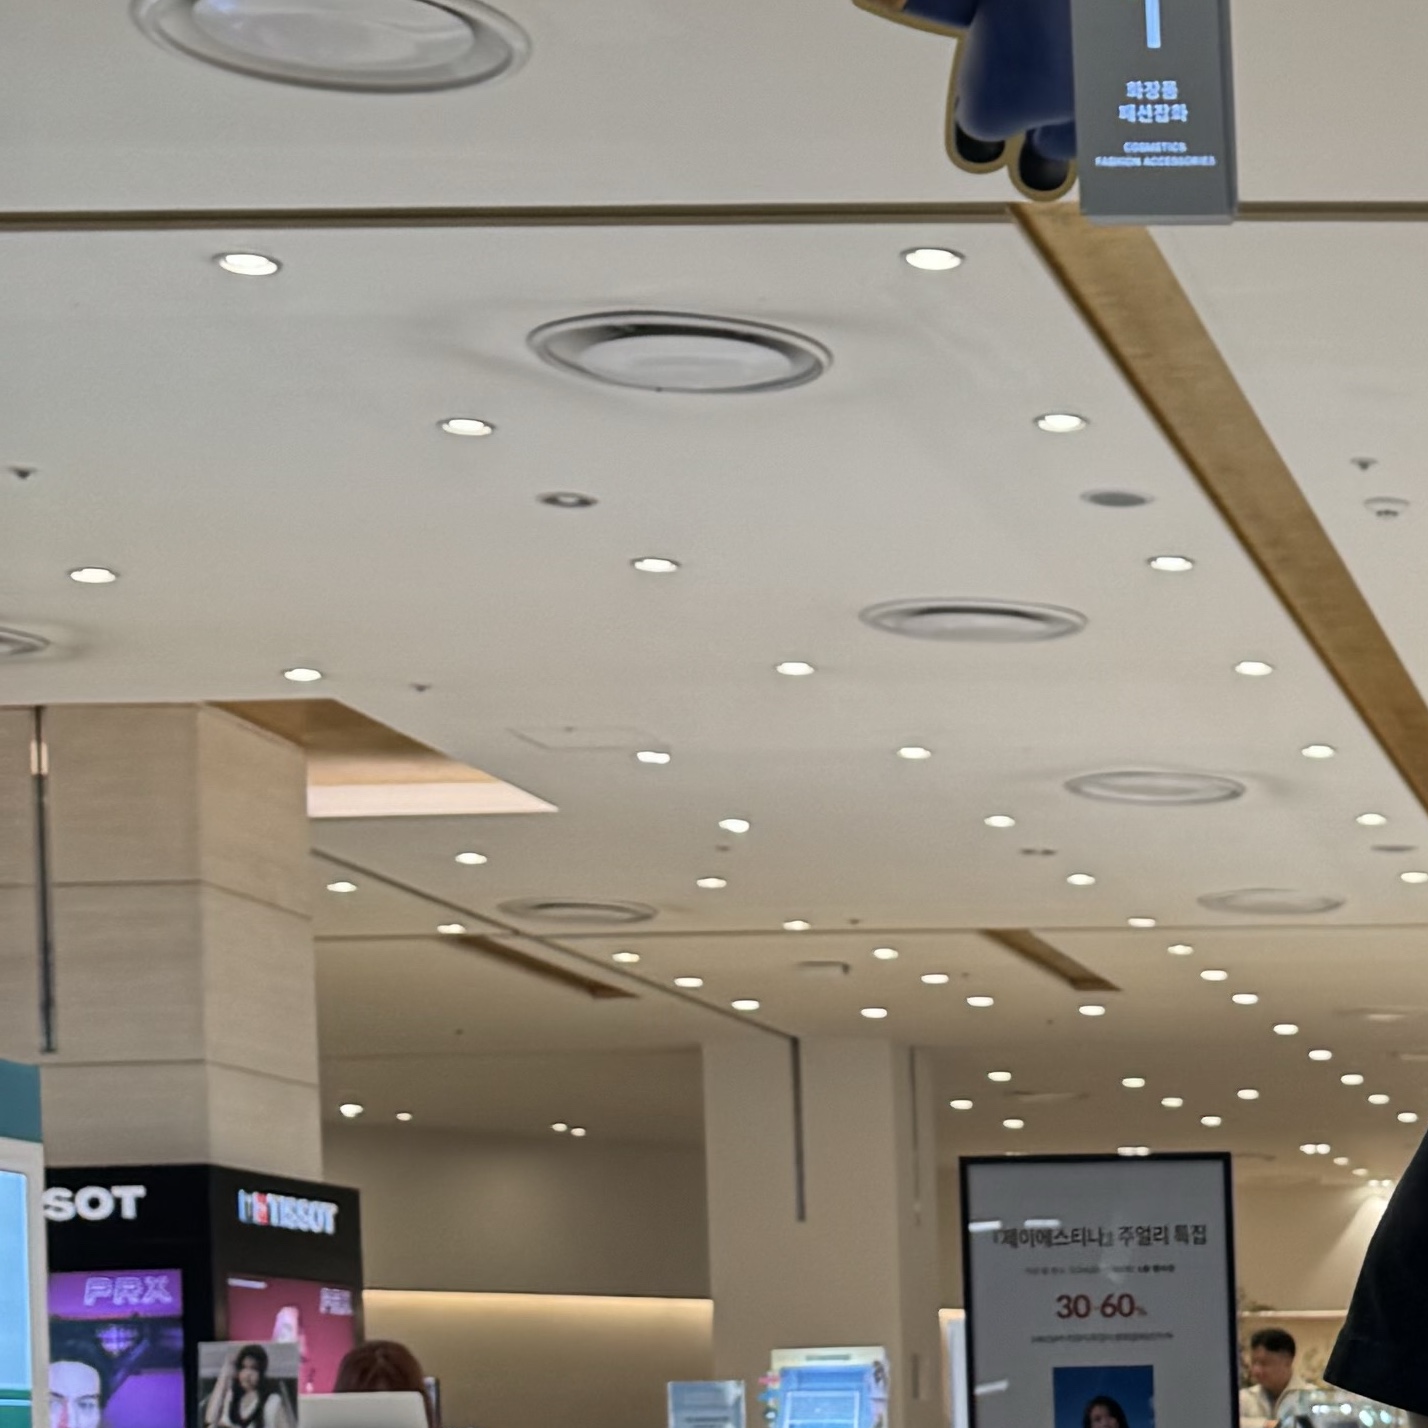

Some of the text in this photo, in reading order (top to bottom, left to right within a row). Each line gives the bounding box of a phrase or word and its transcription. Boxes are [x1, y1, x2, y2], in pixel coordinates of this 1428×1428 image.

[1126, 80, 1178, 100] 화장품
[1118, 103, 1188, 123] 패션잡화
[1118, 1225, 1169, 1247] 주얼리
[1175, 1224, 1206, 1246] 특집
[84, 1276, 173, 1306] PRX
